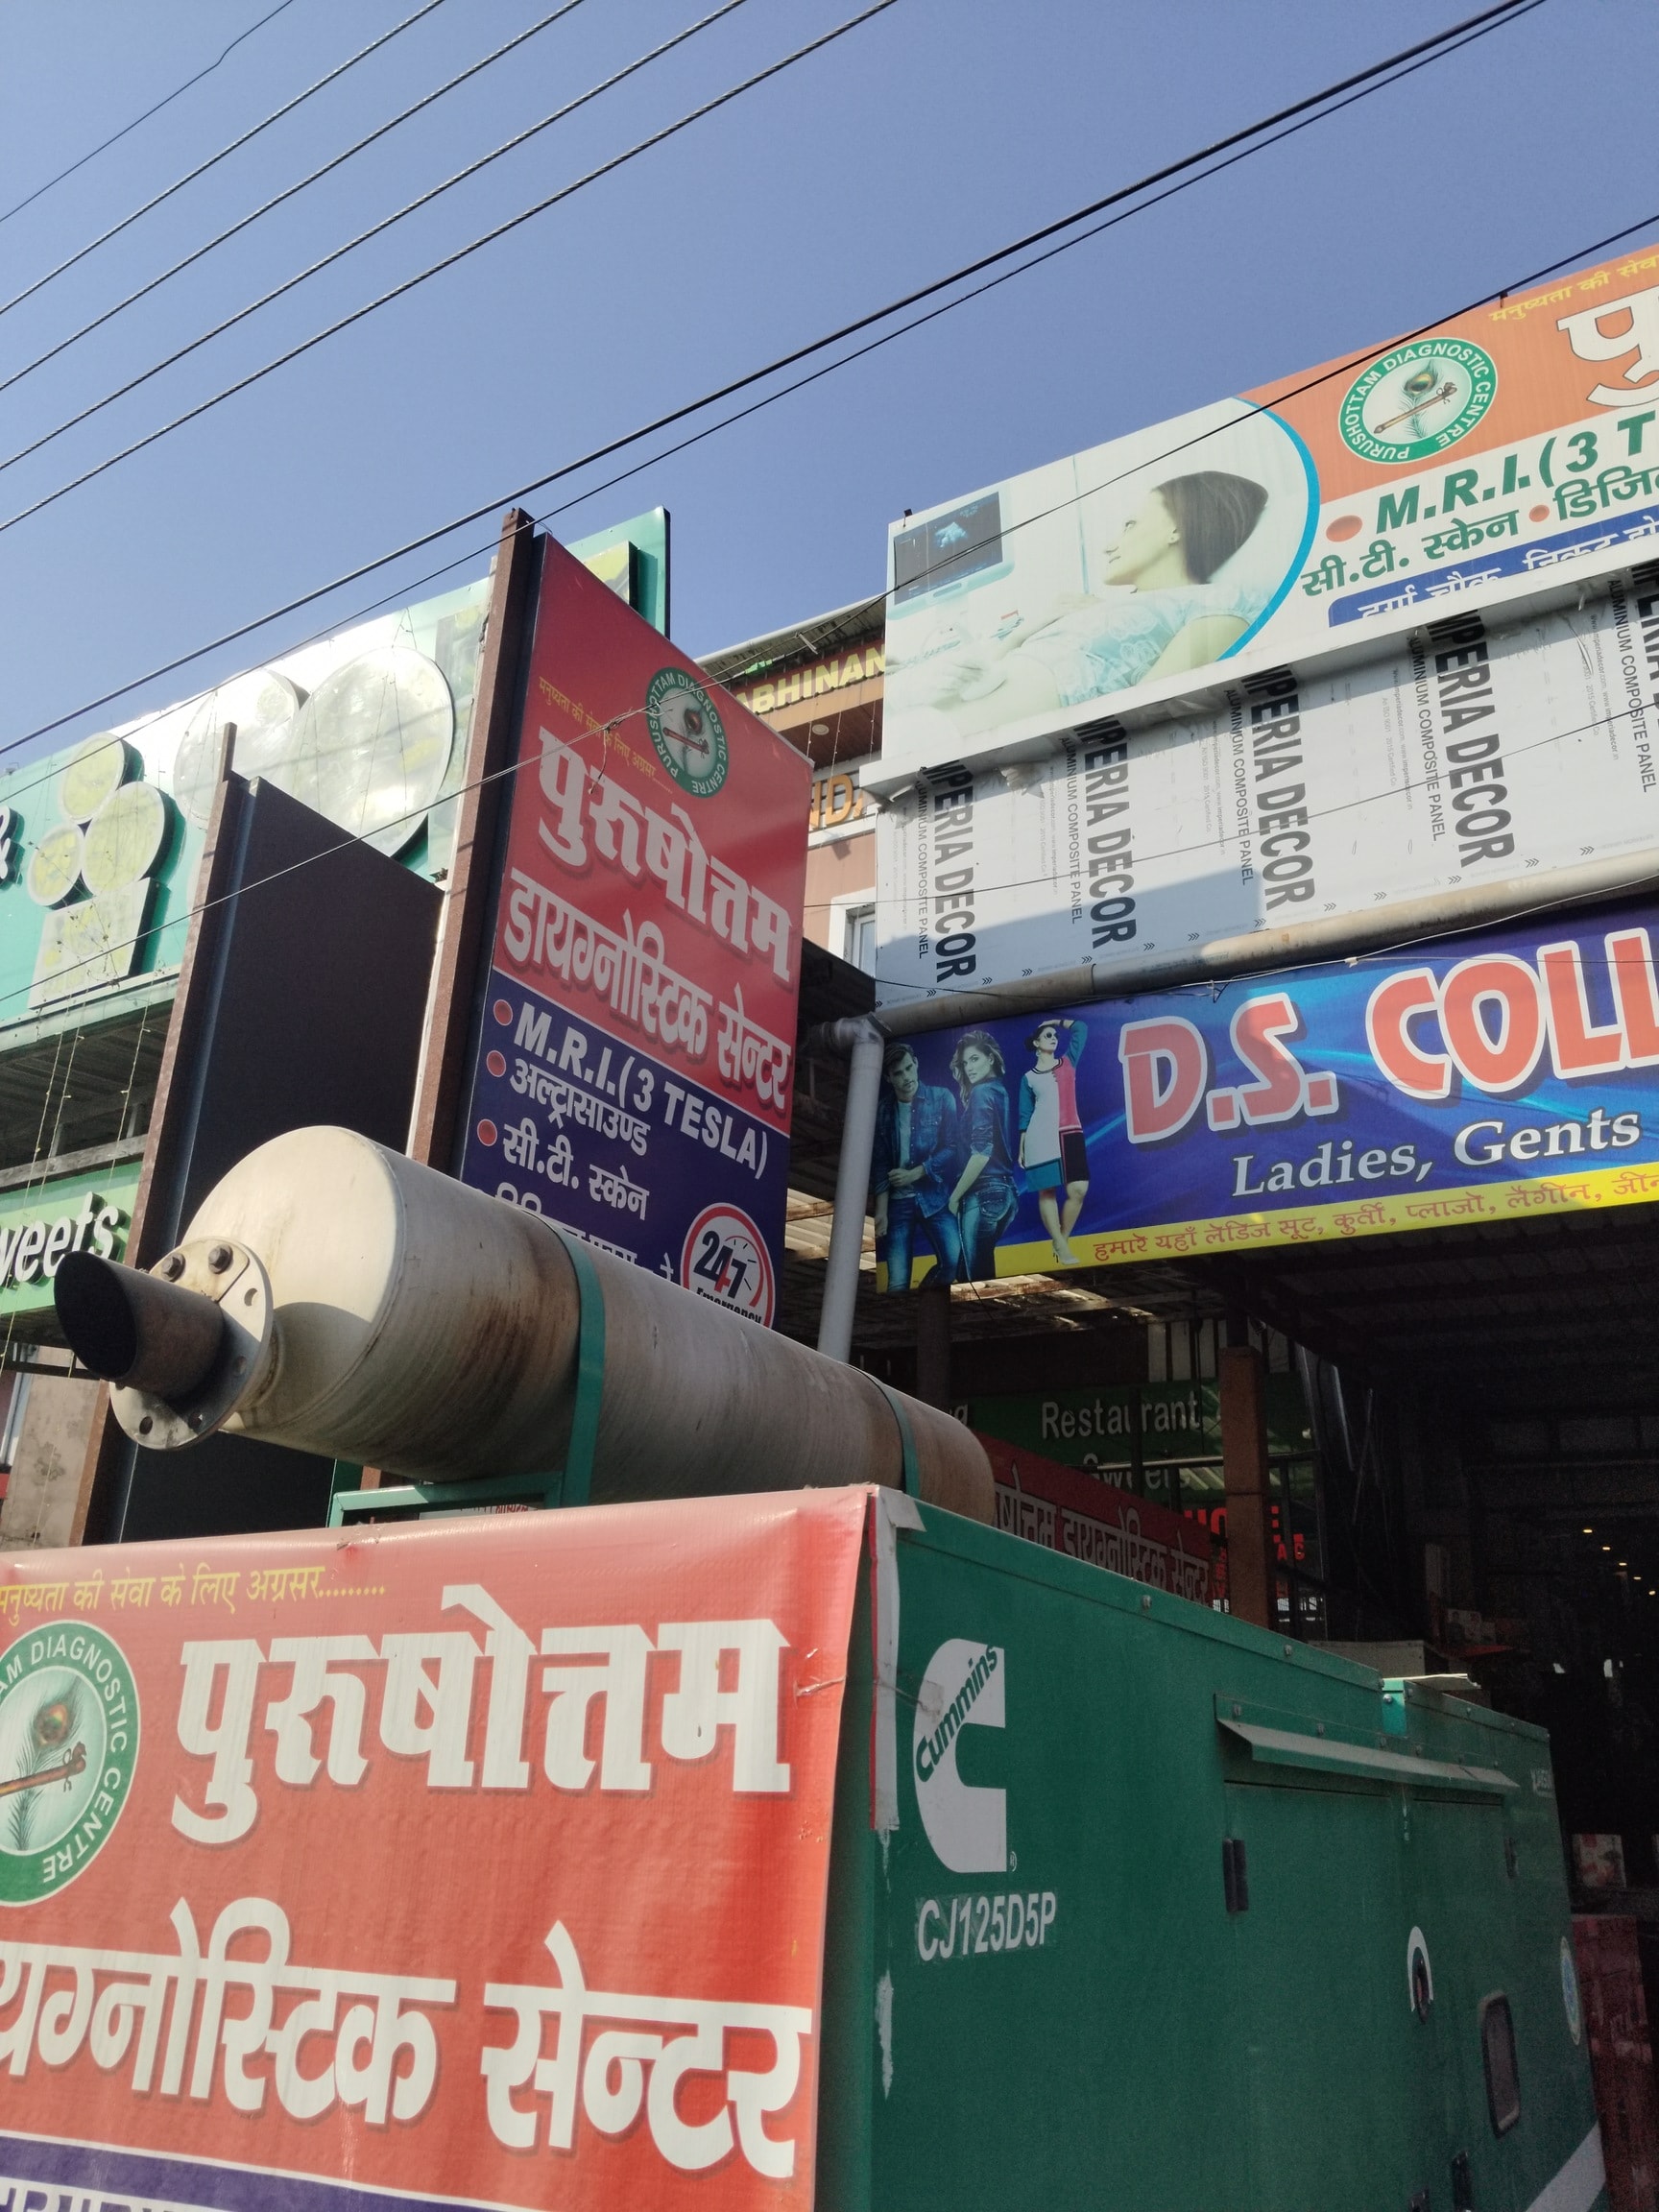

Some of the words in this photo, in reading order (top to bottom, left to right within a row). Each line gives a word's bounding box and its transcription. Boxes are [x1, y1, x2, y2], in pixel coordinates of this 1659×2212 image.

[1489, 285, 1573, 322] मनुष्यता
[1575, 271, 1612, 294] की
[1383, 343, 1489, 379] DIAGNOSTIC
[1344, 371, 1410, 463] PURUSHOTTAM
[1435, 381, 1490, 448] CENTRE
[1421, 509, 1521, 561] स्केन
[1552, 466, 1659, 521] डिजि
[539, 676, 571, 713] मनुष्यता
[571, 703, 584, 723] की
[678, 673, 727, 761] DIAGNOSTIC
[1224, 688, 1244, 756] ALUMINIUM
[1608, 579, 1631, 653] ALUMINIUM
[1621, 655, 1647, 741] COMPOSITE
[1636, 741, 1657, 793] PANEL
[691, 762, 726, 795] CENTRE
[1418, 709, 1440, 792] COMPOSITE
[1233, 758, 1250, 836] COMPOSITE
[1428, 794, 1446, 841] PANEL
[1445, 733, 1515, 868] DECOR
[917, 843, 928, 916] COMPOSITE
[1067, 803, 1081, 877] COMPOSITE
[1239, 839, 1254, 885] PANEL
[1257, 782, 1315, 911] DECOR
[934, 867, 976, 983] DECOR
[1070, 882, 1084, 925] PANEL
[1087, 828, 1137, 950] DECOR
[918, 920, 929, 959] PANEL
[504, 867, 712, 1055] डायग्नोस्टिक
[717, 982, 791, 1109] सेन्टर
[1118, 993, 1338, 1144] D.S.
[1365, 928, 1659, 1098] COLL
[510, 1058, 651, 1156] अल्ट्रासाउण्ड
[663, 1082, 768, 1179] TESLA)
[589, 1166, 650, 1220] स्केन
[1232, 1141, 1434, 1197] Ladies,
[1454, 1109, 1642, 1166] Gents
[1094, 1236, 1148, 1262] हमारे
[1155, 1225, 1197, 1251] यहाँ
[1204, 1219, 1271, 1245] लेडिज
[1278, 1215, 1324, 1242] सूट,
[1405, 1192, 1496, 1219] प्लाजो,
[74, 1568, 105, 1610] की
[110, 1566, 156, 1607] सेवा
[160, 1562, 186, 1606] के
[190, 1561, 241, 1614] लिए
[31, 1634, 127, 1753] DIAGNOSTIC
[916, 1645, 998, 1783] Cummins
[42, 1767, 121, 1884] CENTRE
[918, 1891, 1056, 1961] CJ125D5P
[479, 1920, 812, 2178] सेन्टर
